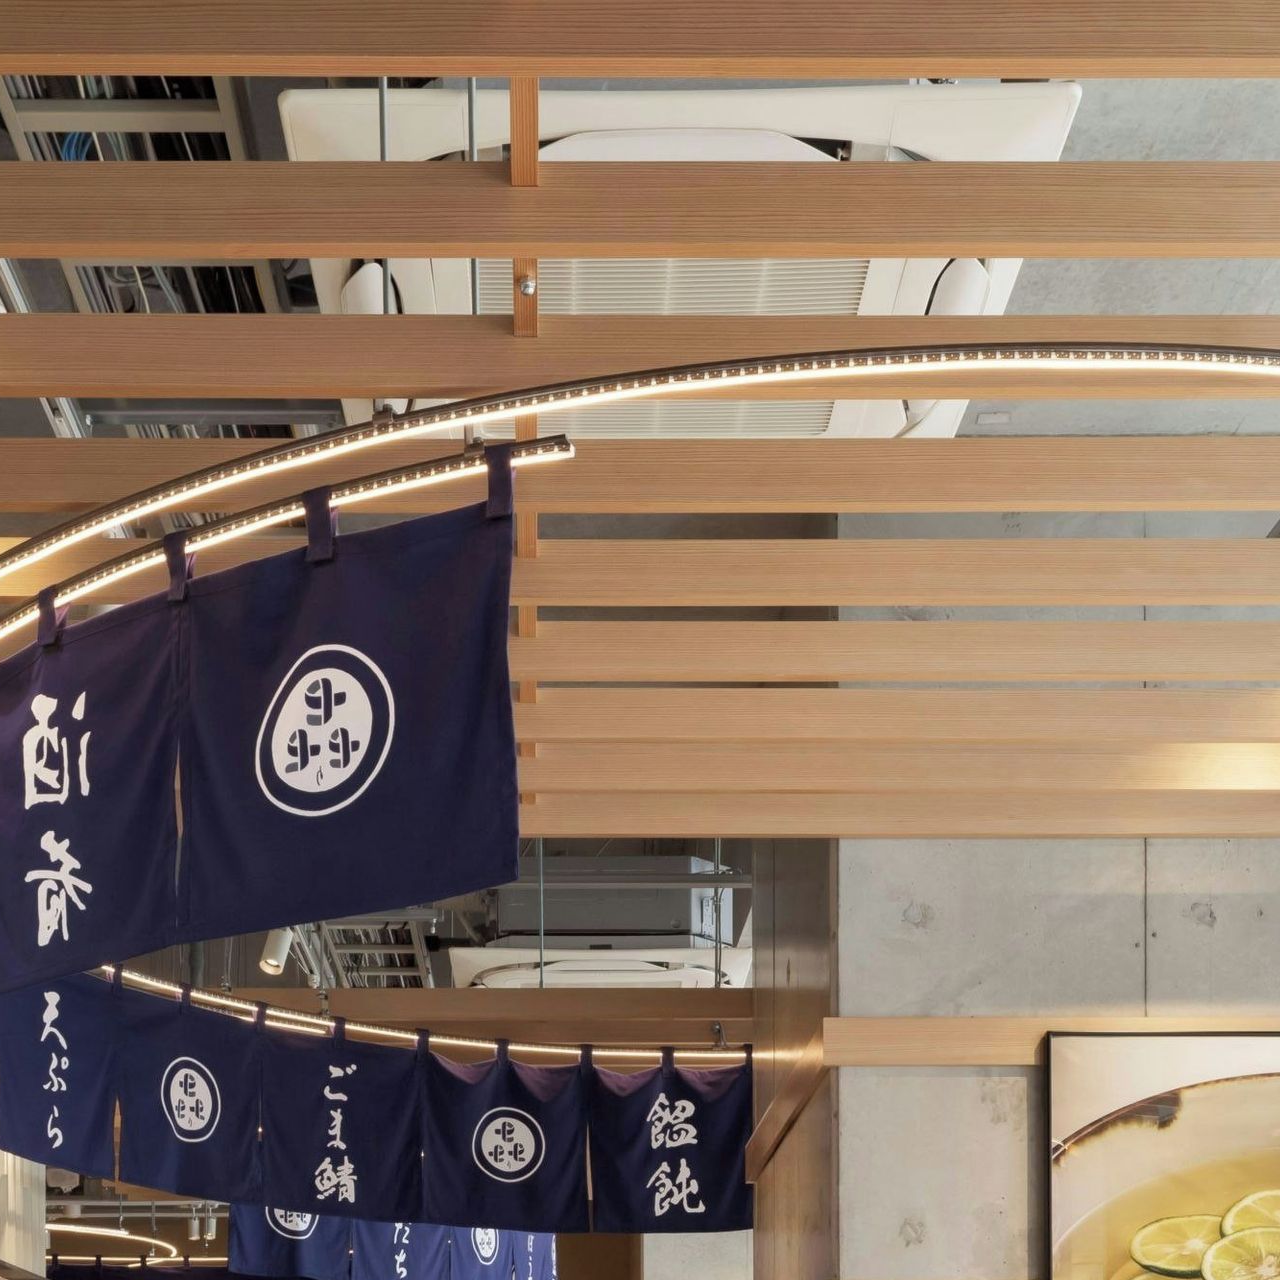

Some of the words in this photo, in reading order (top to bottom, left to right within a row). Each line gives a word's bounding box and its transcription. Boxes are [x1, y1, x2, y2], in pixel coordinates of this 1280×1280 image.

[40, 991, 69, 1149] 天ぷら
[314, 1063, 358, 1204] ごま鯖
[645, 1092, 706, 1217] 饂飩
